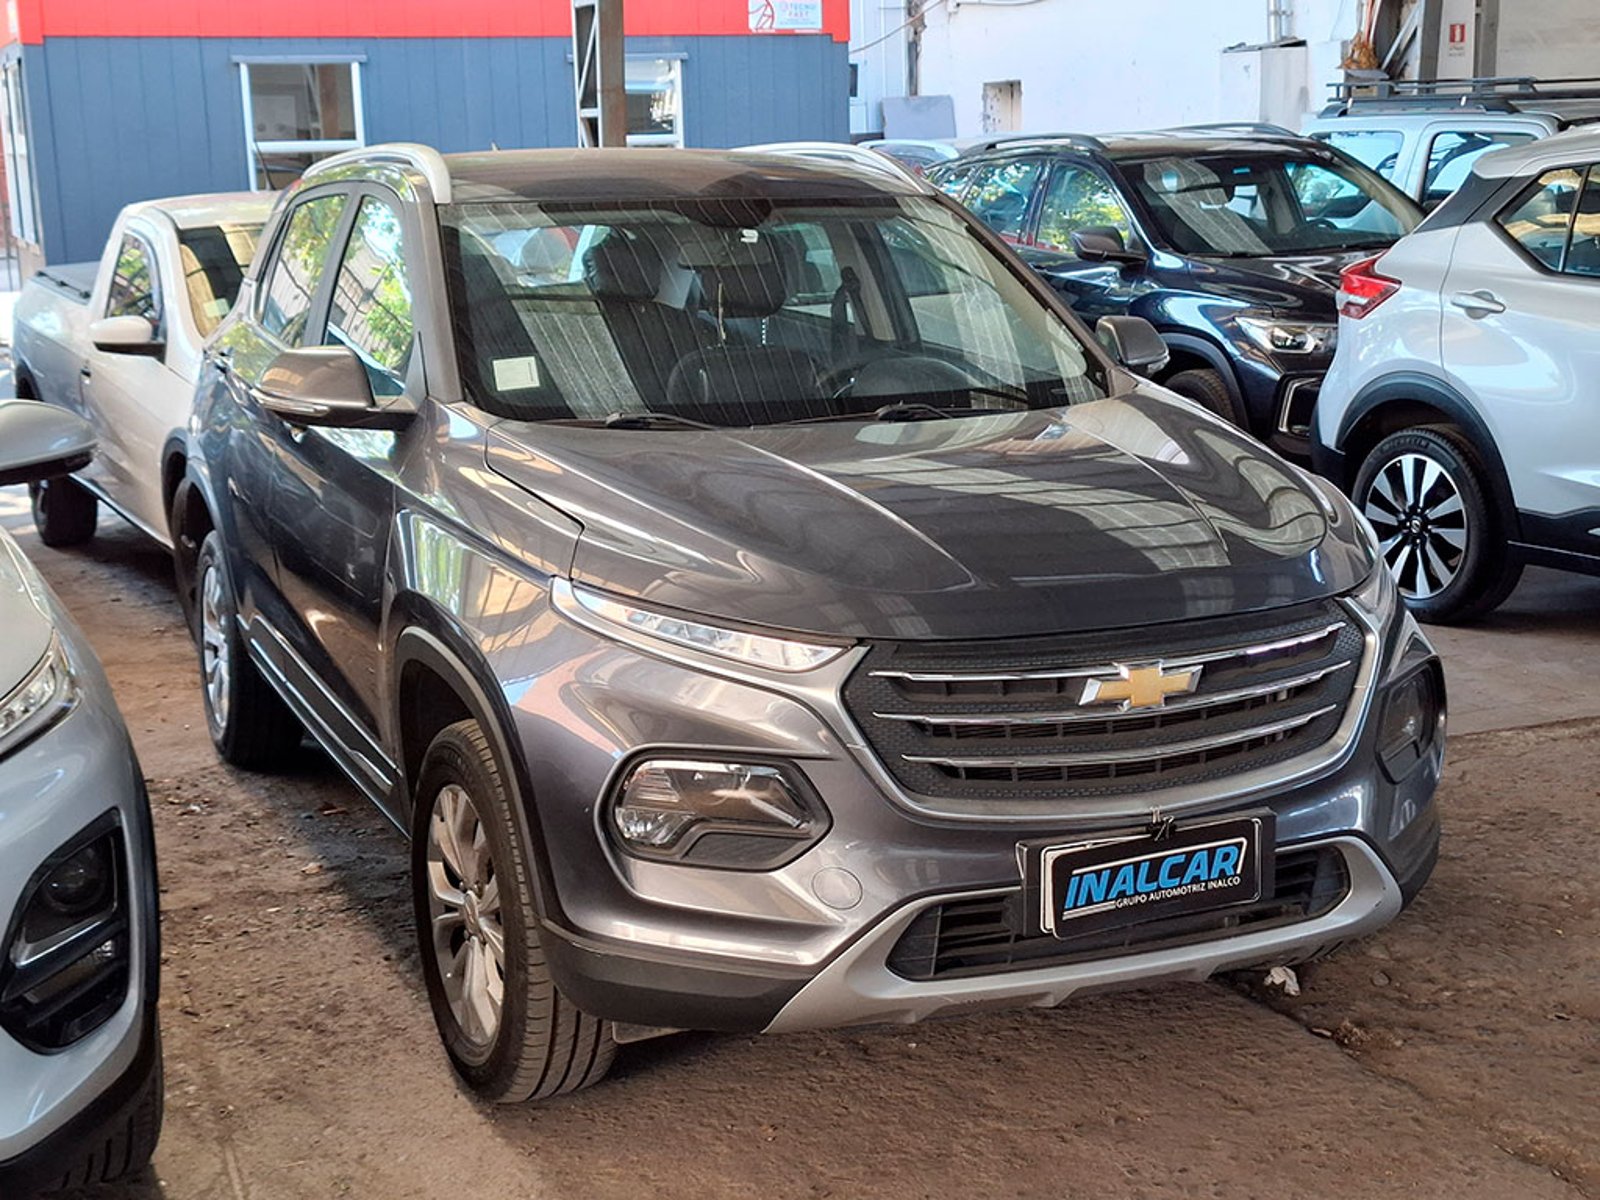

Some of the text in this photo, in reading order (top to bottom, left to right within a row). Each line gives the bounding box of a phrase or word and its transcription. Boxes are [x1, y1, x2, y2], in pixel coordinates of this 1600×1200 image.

[1064, 845, 1239, 909] INALCAR
[1116, 876, 1241, 908] GRUPO AUTOMOTRIZ INALCO
